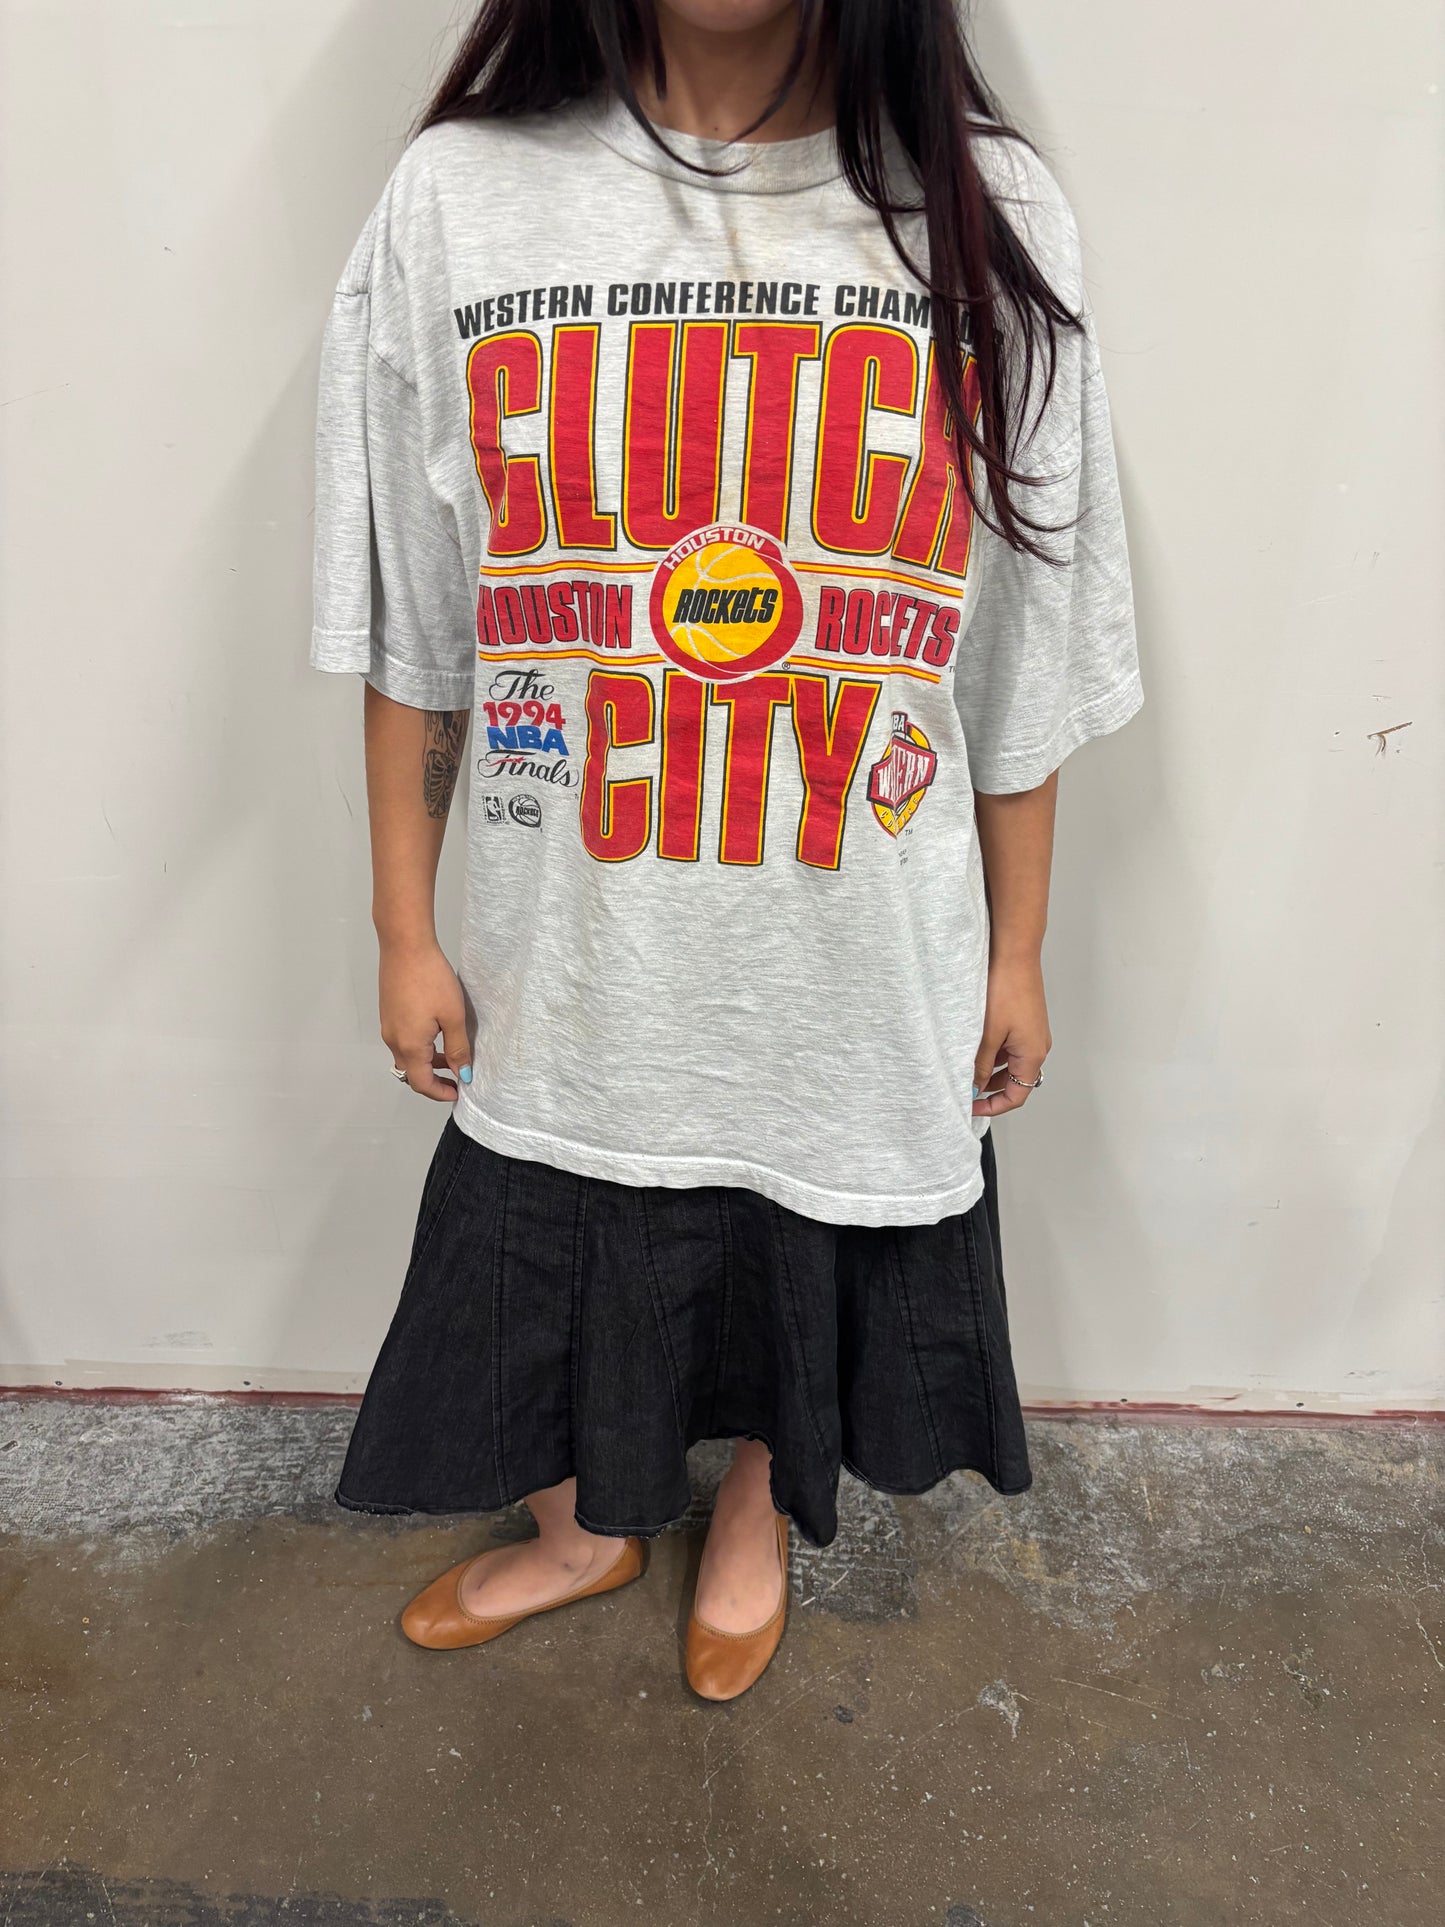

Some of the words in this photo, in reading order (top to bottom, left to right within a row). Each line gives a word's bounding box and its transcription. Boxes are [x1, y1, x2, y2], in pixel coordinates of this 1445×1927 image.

[453, 284, 594, 340] WESTERN
[607, 281, 821, 316] CONFERENCE
[466, 319, 983, 580] CLUTCH
[663, 527, 766, 571] HOUSTON
[476, 580, 633, 649] HOUSTON
[814, 585, 961, 667] ROCETS
[488, 668, 555, 701] The
[482, 700, 566, 731] 1994
[891, 713, 906, 732] BA
[486, 725, 570, 756] NBA
[477, 749, 580, 788] Finals
[580, 667, 883, 871] CITY
